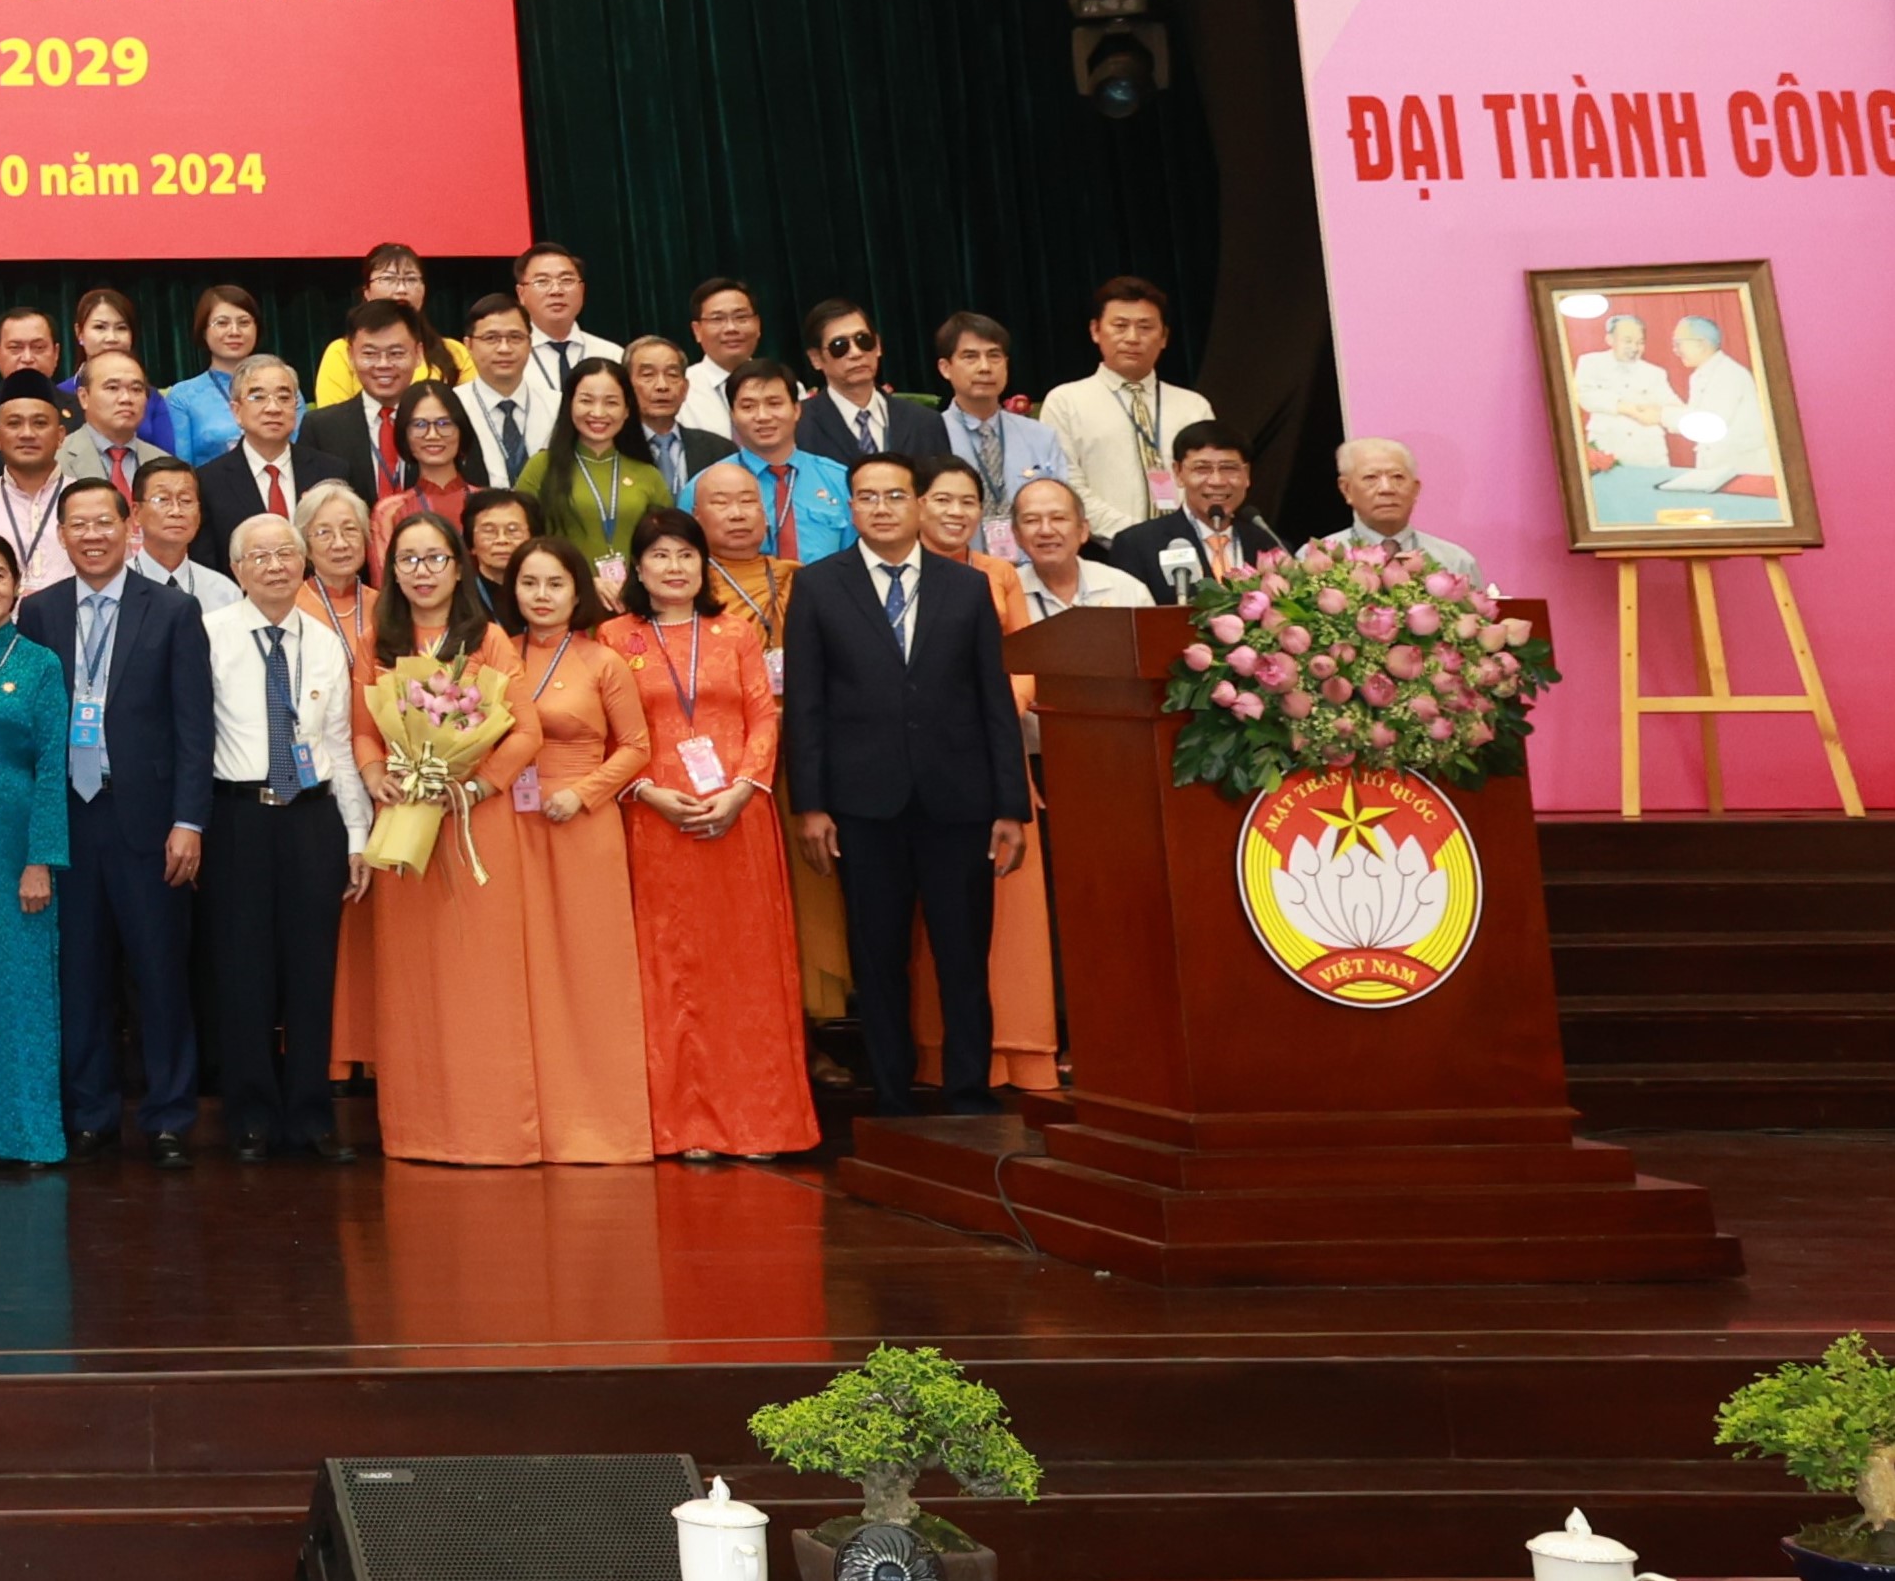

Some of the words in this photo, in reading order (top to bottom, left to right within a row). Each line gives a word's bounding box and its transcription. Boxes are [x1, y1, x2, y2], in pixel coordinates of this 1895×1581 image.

[0, 37, 149, 87] 2029
[1347, 95, 1465, 201] ĐẠI
[1482, 74, 1707, 180] THÀNH
[1727, 72, 1895, 178] CÔNG
[39, 152, 140, 196] năm
[150, 152, 266, 195] 2024
[1264, 793, 1296, 834] MẶT
[1389, 781, 1439, 824] QUỐC
[1318, 956, 1366, 984] VIỆT
[1371, 958, 1418, 986] NAM
